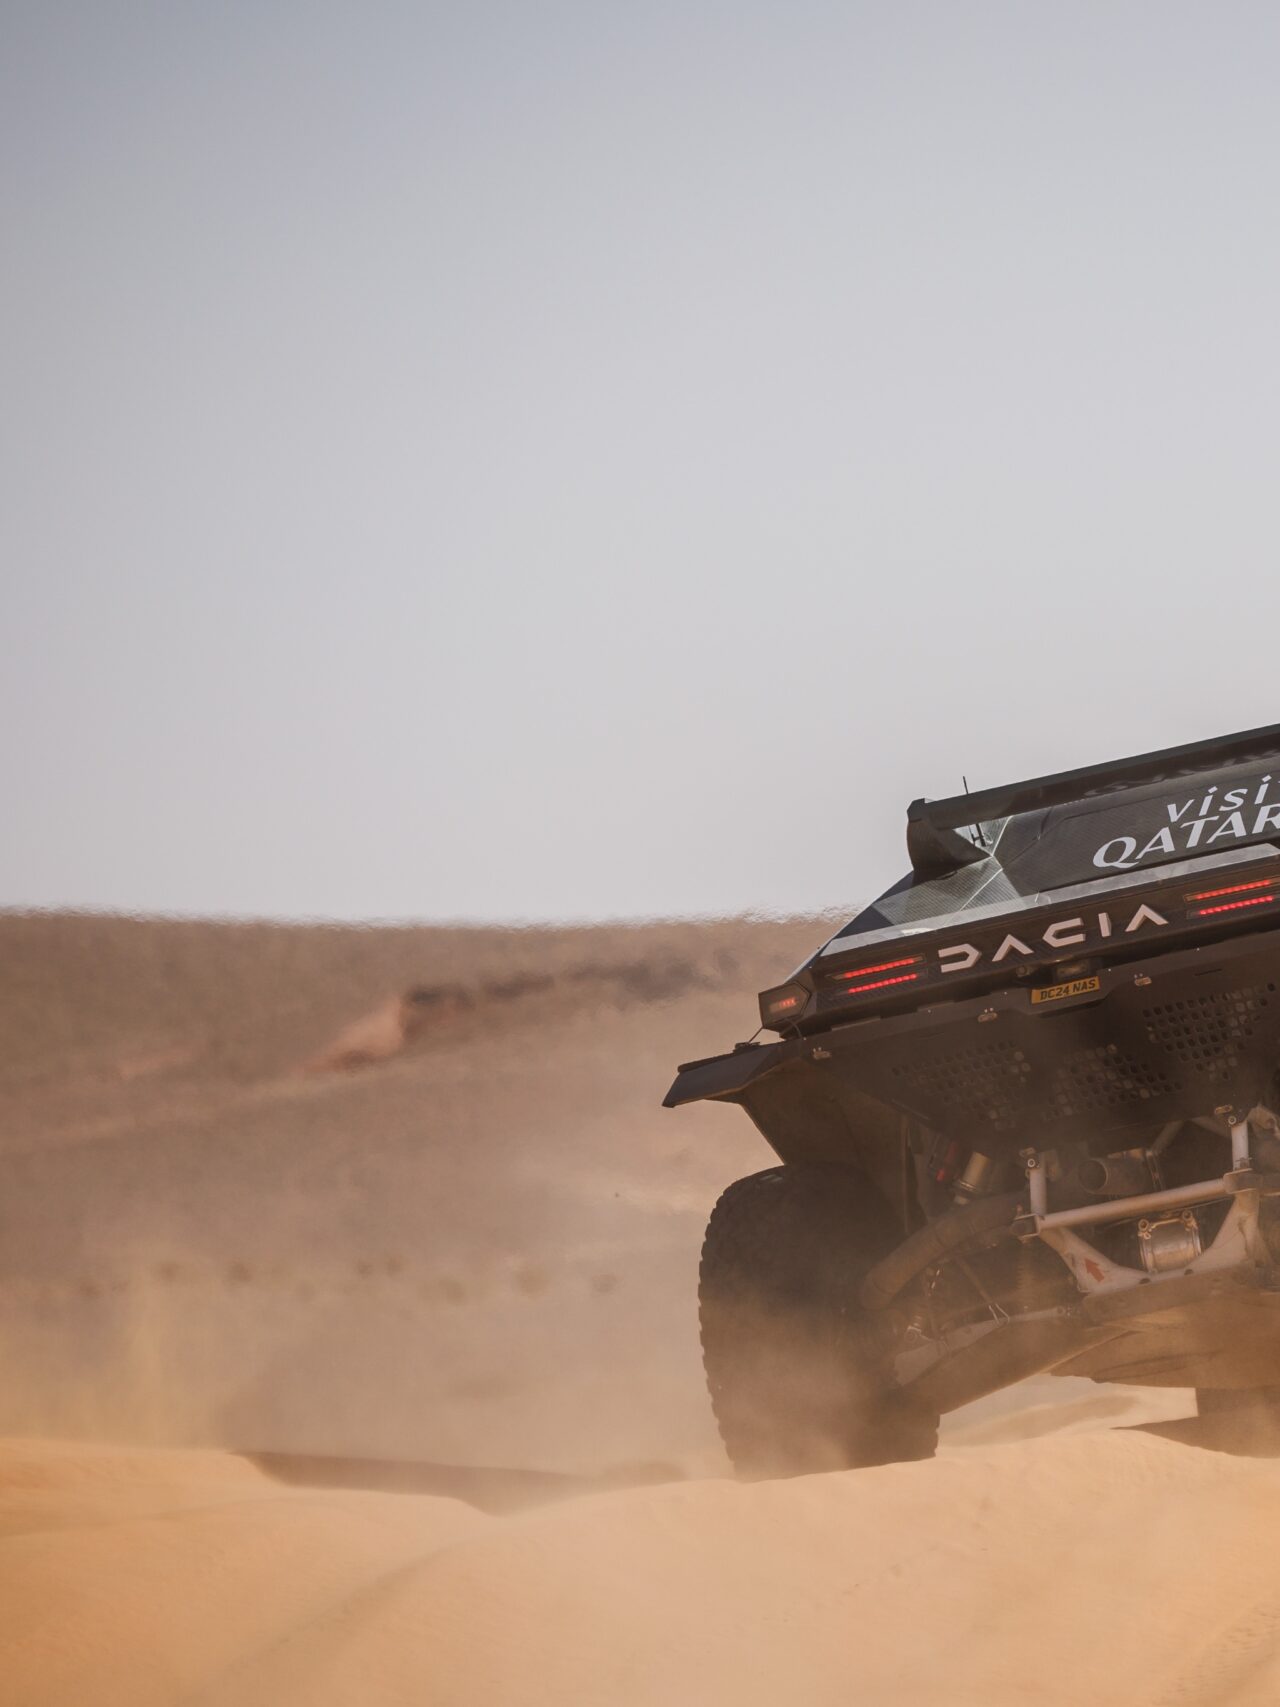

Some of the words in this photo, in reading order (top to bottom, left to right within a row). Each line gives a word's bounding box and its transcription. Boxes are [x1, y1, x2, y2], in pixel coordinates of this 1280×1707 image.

[937, 903, 1169, 973] DACIA
[1040, 985, 1070, 1000] DC24
[1072, 979, 1096, 992] NAS
